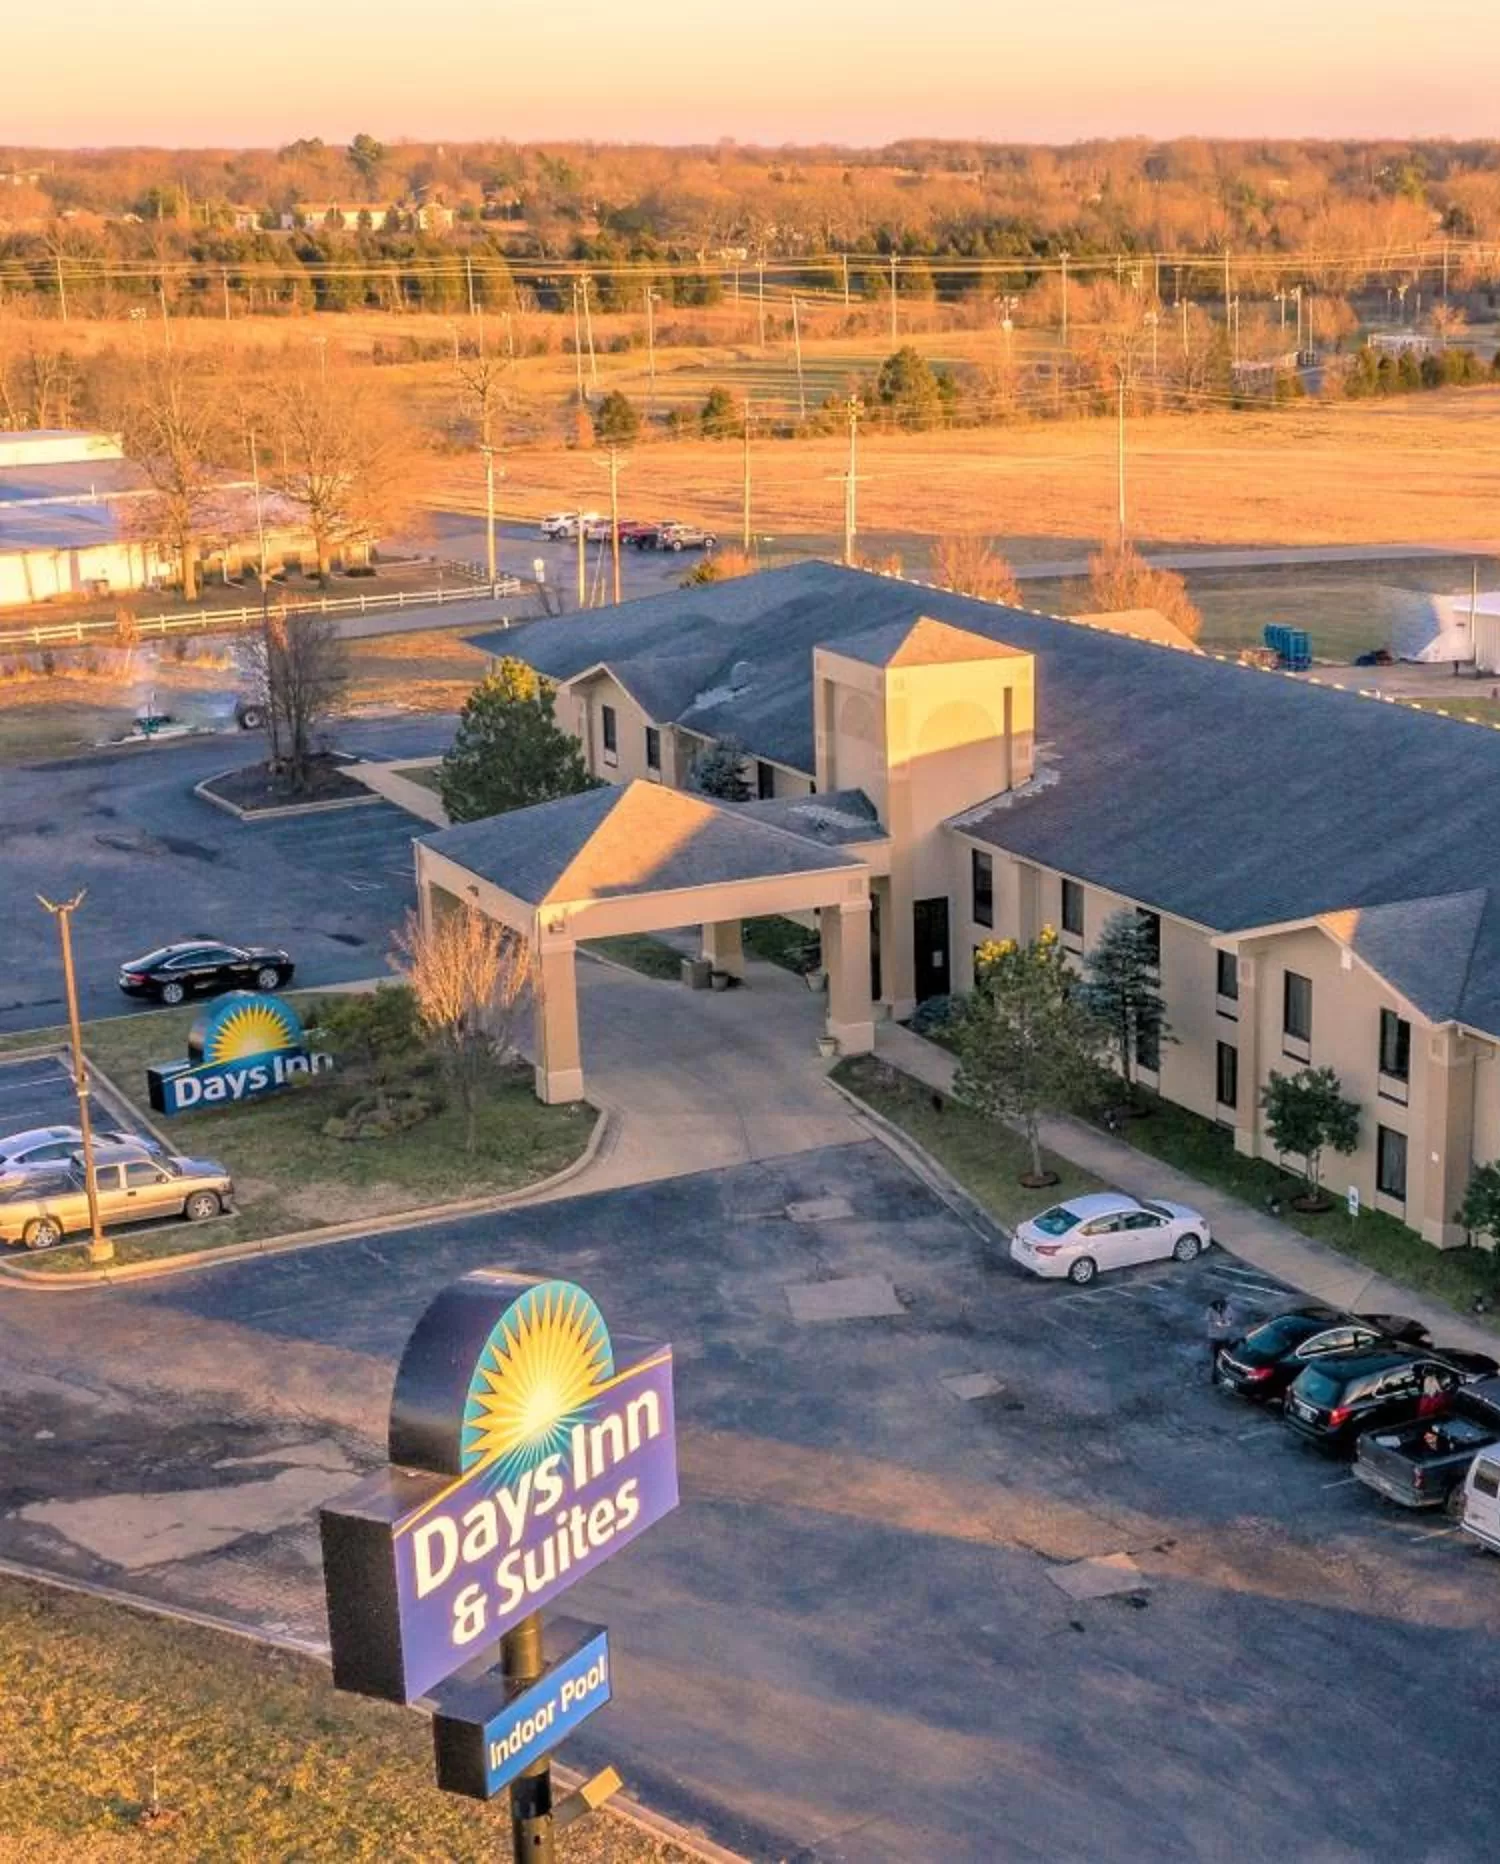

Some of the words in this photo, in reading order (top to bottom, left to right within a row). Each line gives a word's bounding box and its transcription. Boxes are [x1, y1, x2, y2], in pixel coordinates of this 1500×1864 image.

[174, 1064, 269, 1108] Days
[273, 1052, 333, 1084] Inn
[413, 1452, 564, 1600] Days
[570, 1389, 661, 1490] Inn
[451, 1582, 489, 1645] &
[496, 1477, 641, 1616] Suites
[490, 1699, 557, 1771] Indoor
[561, 1655, 606, 1713] Pool
